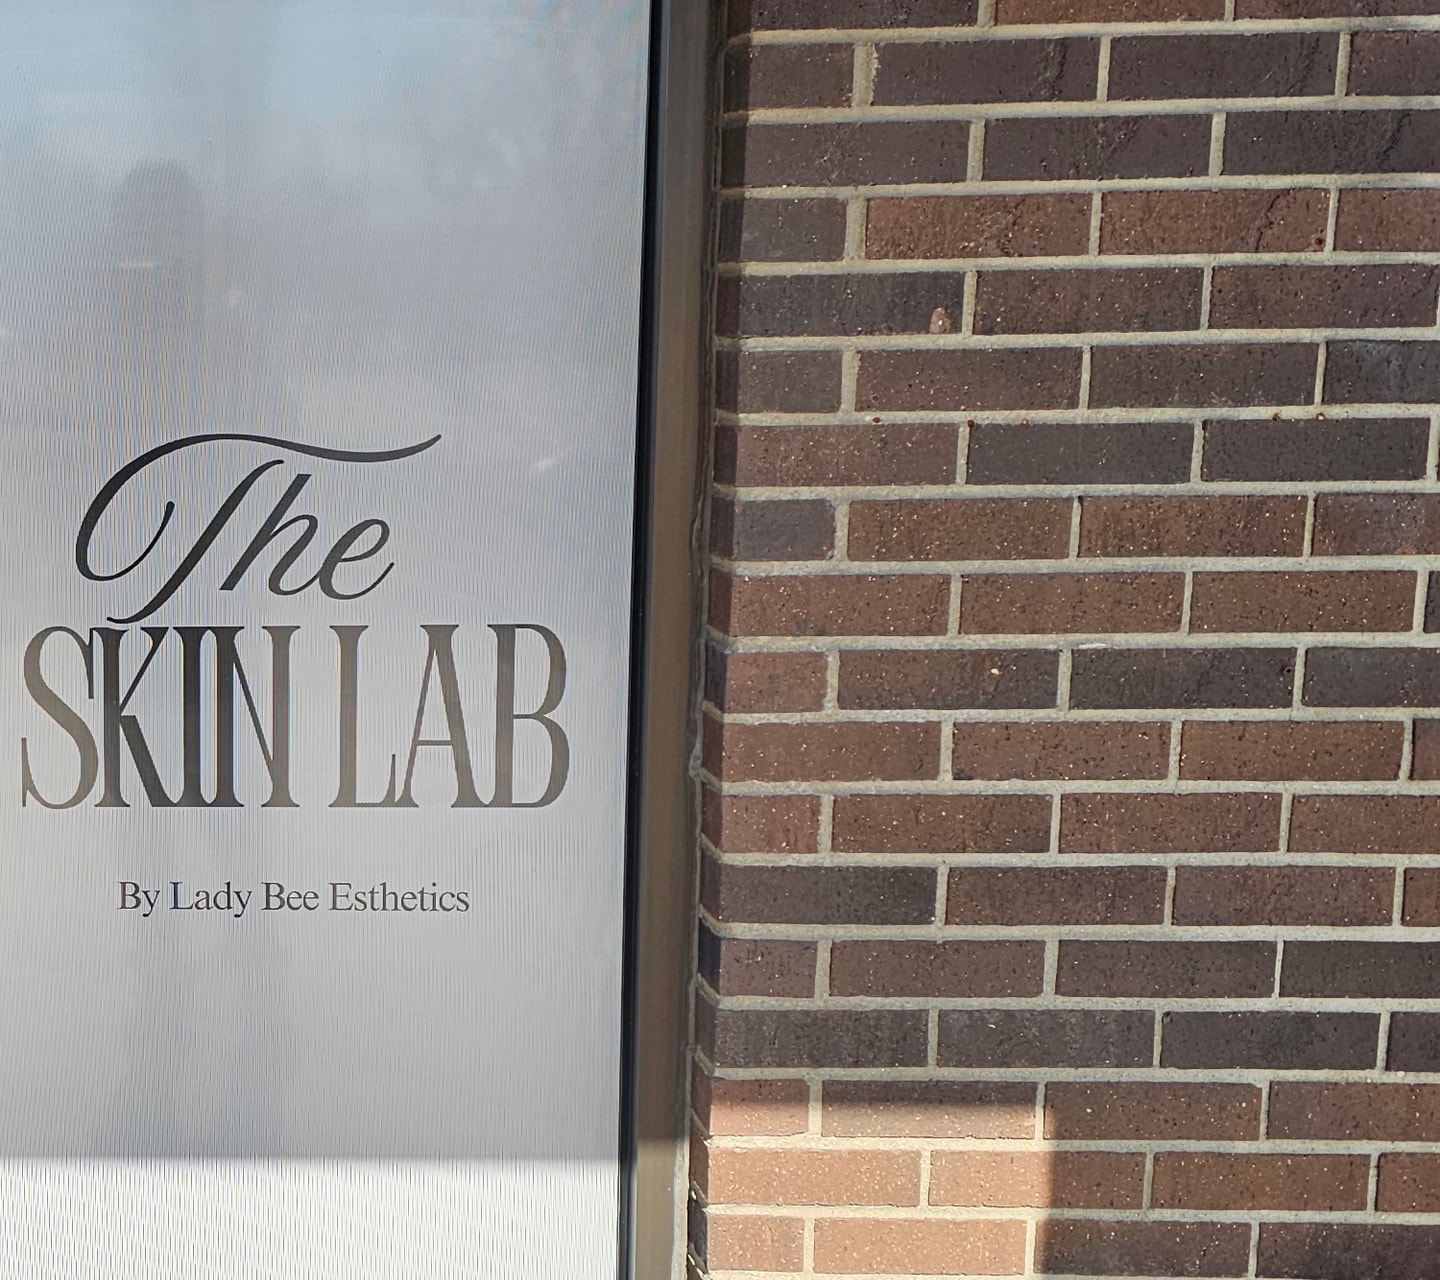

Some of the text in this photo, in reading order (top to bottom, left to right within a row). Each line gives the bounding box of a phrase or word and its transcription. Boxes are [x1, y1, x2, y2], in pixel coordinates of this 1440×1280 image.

[75, 433, 442, 624] The
[21, 623, 570, 810] SKIN LAB
[118, 881, 470, 918] By Lady Bee Esthetics
